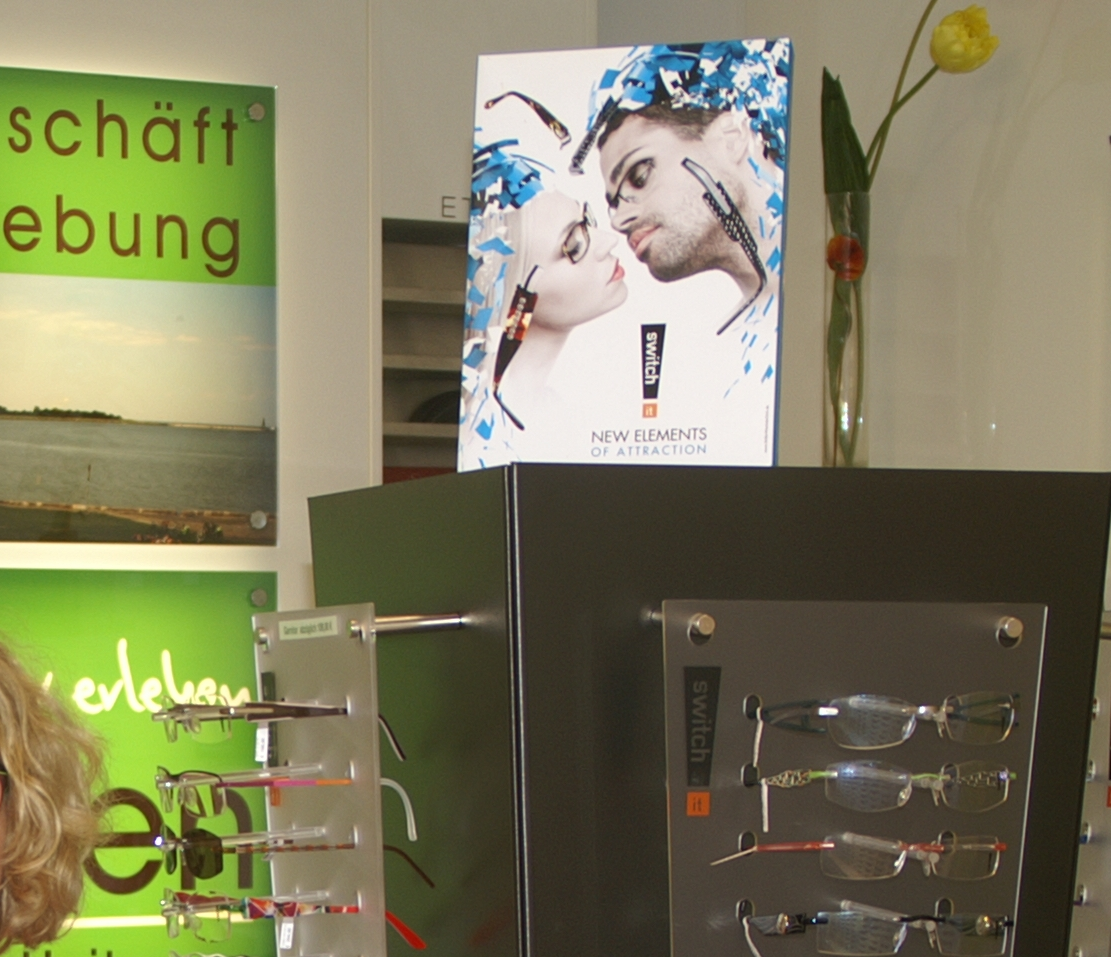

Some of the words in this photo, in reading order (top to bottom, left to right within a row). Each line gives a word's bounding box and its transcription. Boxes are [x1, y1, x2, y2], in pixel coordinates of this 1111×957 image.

[644, 331, 661, 386] switch
[591, 429, 630, 444] NEW
[634, 427, 708, 443] ELEMENTS
[591, 446, 610, 458] OF
[616, 444, 708, 458] ATTRACTION
[71, 637, 252, 715] erleben
[691, 680, 713, 763] switch
